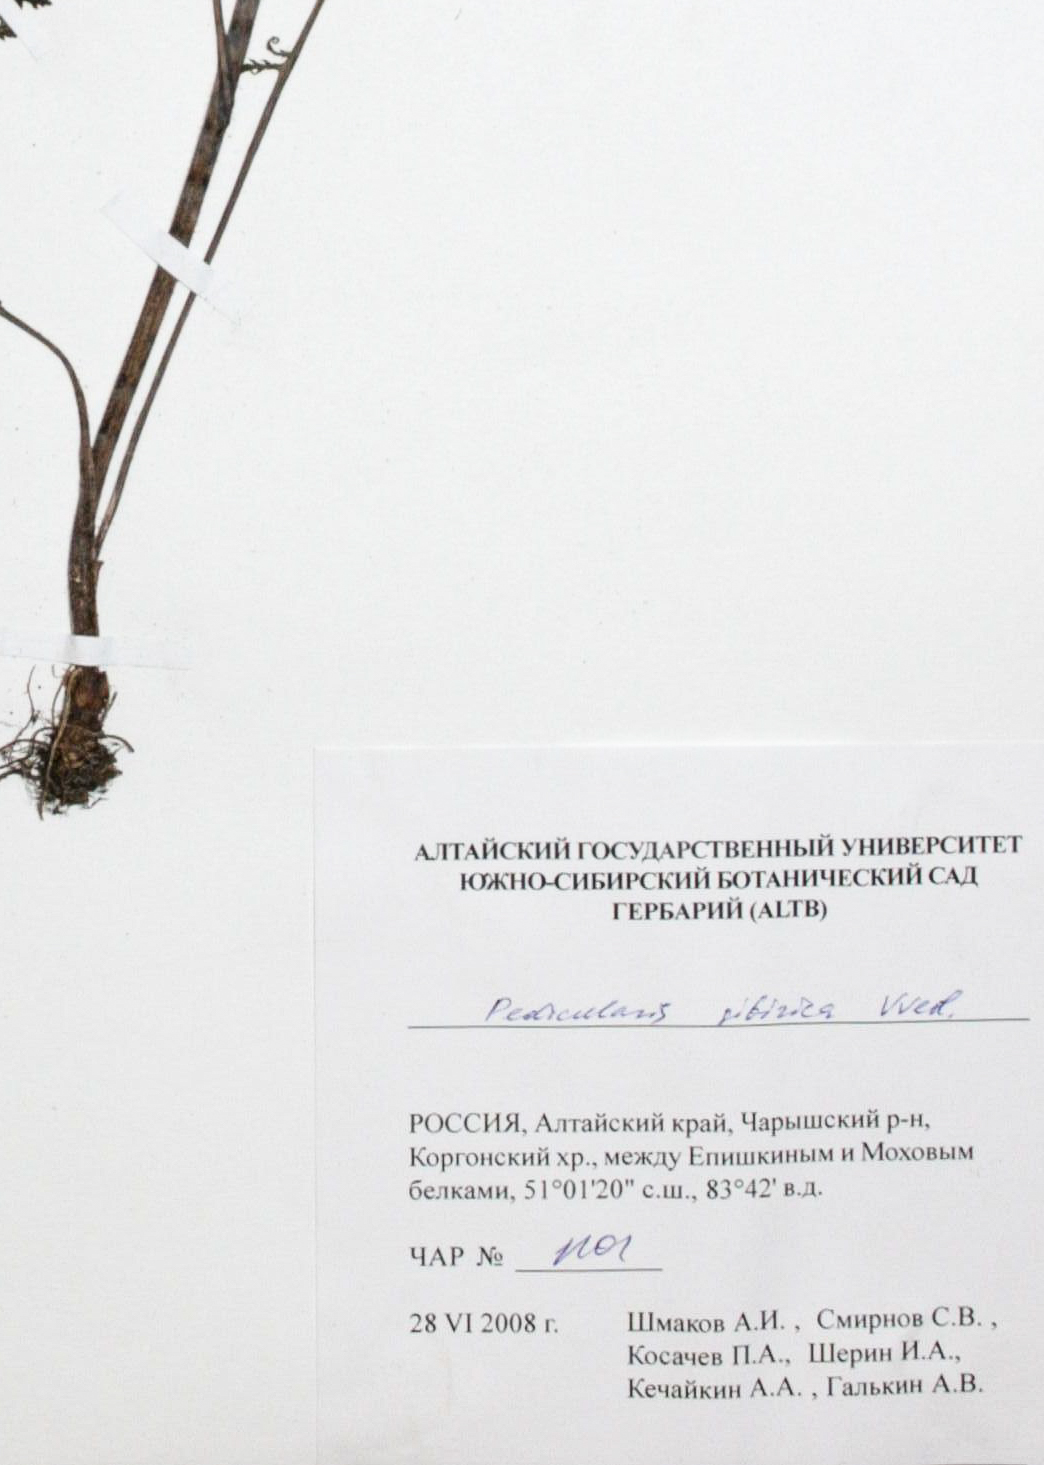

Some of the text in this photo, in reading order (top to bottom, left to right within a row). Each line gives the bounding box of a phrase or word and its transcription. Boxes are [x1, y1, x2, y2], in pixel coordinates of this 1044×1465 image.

[414, 833, 1024, 863] АЛТАЙСКИЙ ГОСУДАРСТВЕННЫЙ УНИВЕРСИТЕТ
[460, 863, 979, 892] ЮЖНО-СИБИРСКИЙ БОТАНИЧЕСКИЙ САД
[612, 896, 828, 923] ГЕРБАРИЙ (ALTB)
[409, 1108, 931, 1140] РОССИЯ, Алтайский край, Чарышский р-н,
[409, 1139, 974, 1175] Коргонский хр., между Епишкиным и Моховым
[408, 1179, 516, 1204] белками,
[641, 1183, 698, 1204] с.ш.,
[783, 1181, 823, 1202] в.д.
[409, 1245, 504, 1267] ЧАР №
[409, 1312, 559, 1334] 28 VI 2008 г.
[627, 1311, 726, 1334] Шмаков
[816, 1308, 924, 1336] Смирнов
[627, 1339, 961, 1369] Косачев П.А., Шерин И.А.,
[627, 1377, 742, 1401] Кечайкин
[826, 1375, 923, 1397] Галькин
[931, 1372, 984, 1394] А.В.
